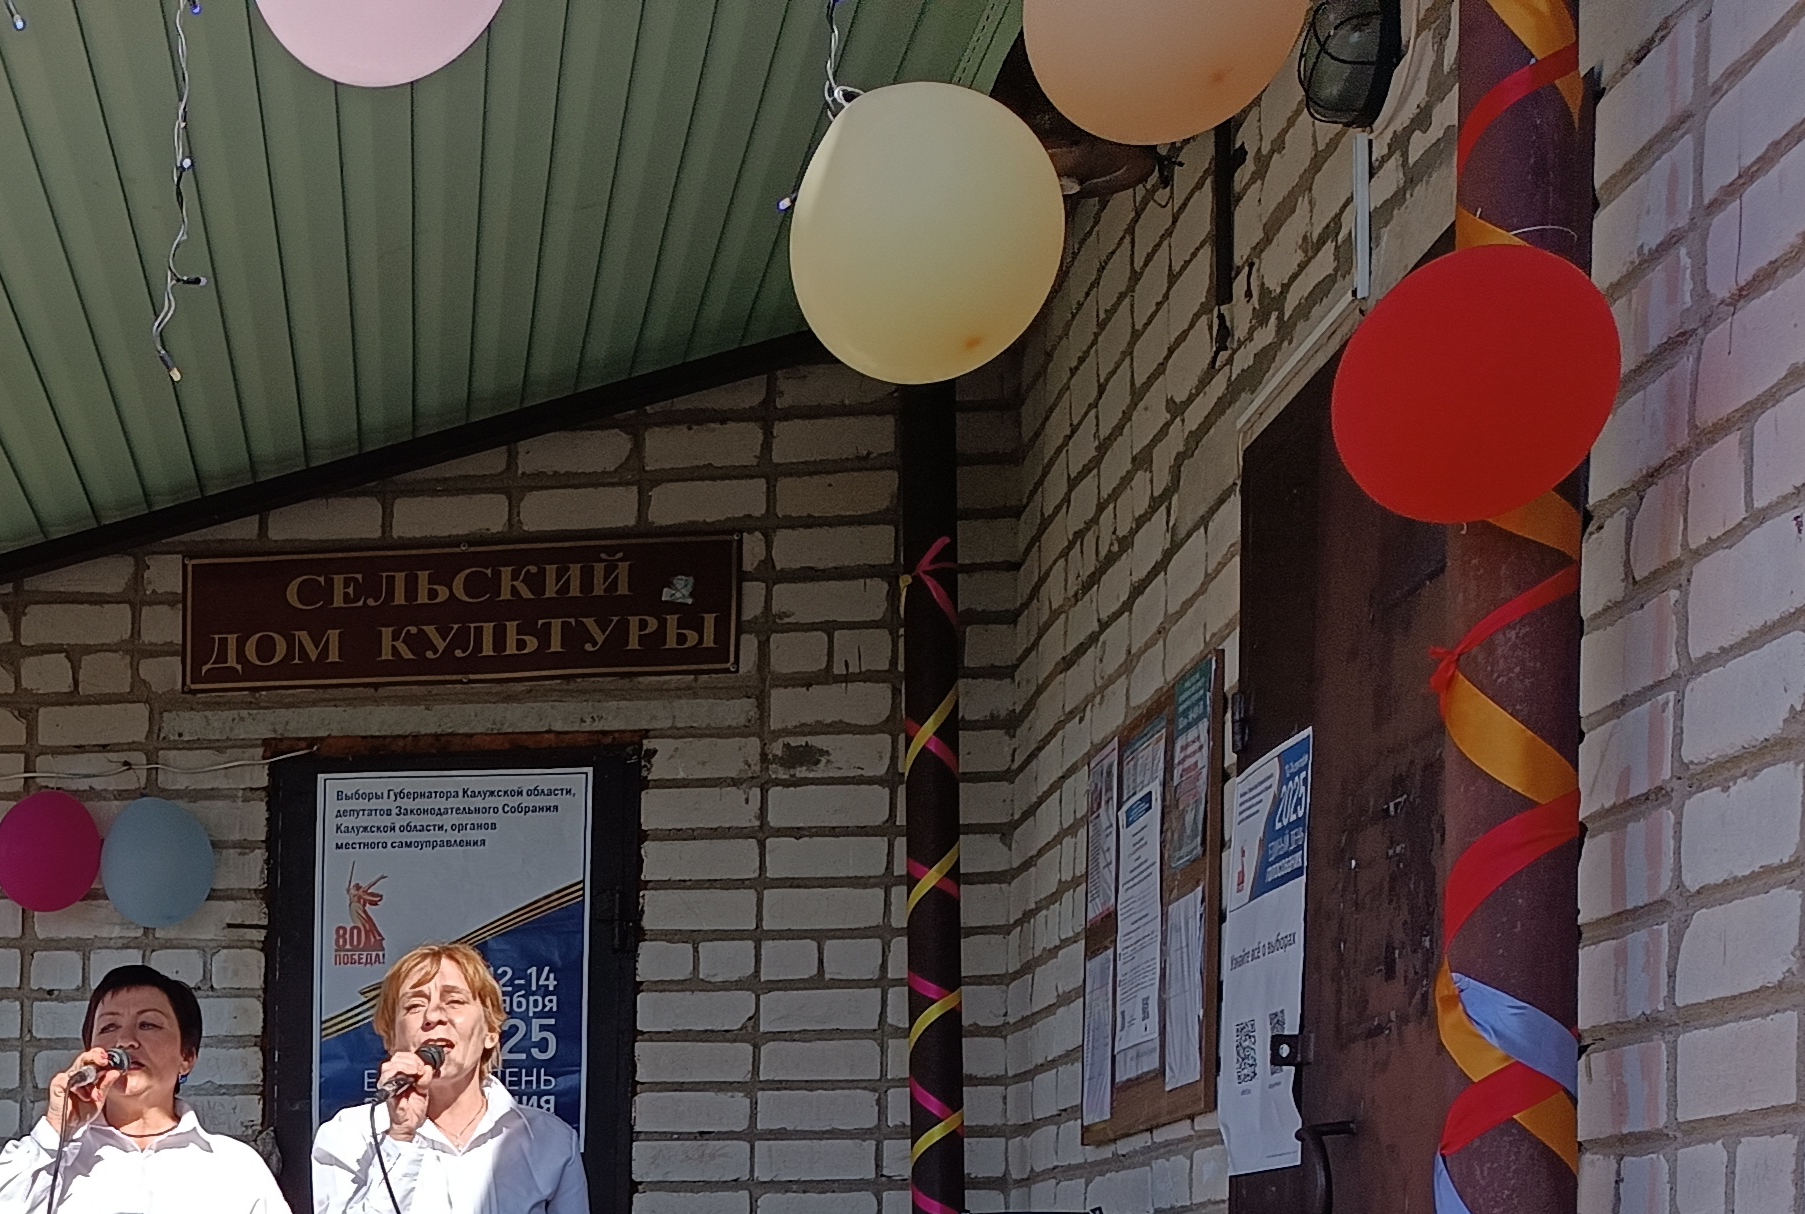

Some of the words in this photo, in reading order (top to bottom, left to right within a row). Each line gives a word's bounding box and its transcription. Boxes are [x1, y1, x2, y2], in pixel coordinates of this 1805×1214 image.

[286, 551, 634, 610] СЕЛЬСКИЙ
[201, 627, 344, 676] ДОМ
[376, 612, 721, 661] КУЛЬТУРЫ
[336, 788, 384, 802] Выборы
[387, 788, 459, 802] Губернатора
[462, 786, 524, 800] Калужской
[526, 785, 576, 797] области,
[1275, 771, 1306, 830] 2025
[335, 807, 393, 819] депутатов
[395, 804, 499, 817] Законодательного
[502, 802, 559, 816] Собрания
[335, 821, 396, 836] Калужской
[398, 821, 448, 834] области,
[450, 822, 497, 834] органов
[335, 840, 388, 850] местного
[390, 838, 486, 851] самоуправления
[334, 925, 363, 949] 80
[334, 953, 386, 967] ПОБЕДА!
[490, 966, 558, 991] 2-14
[501, 1018, 557, 1060] 25
